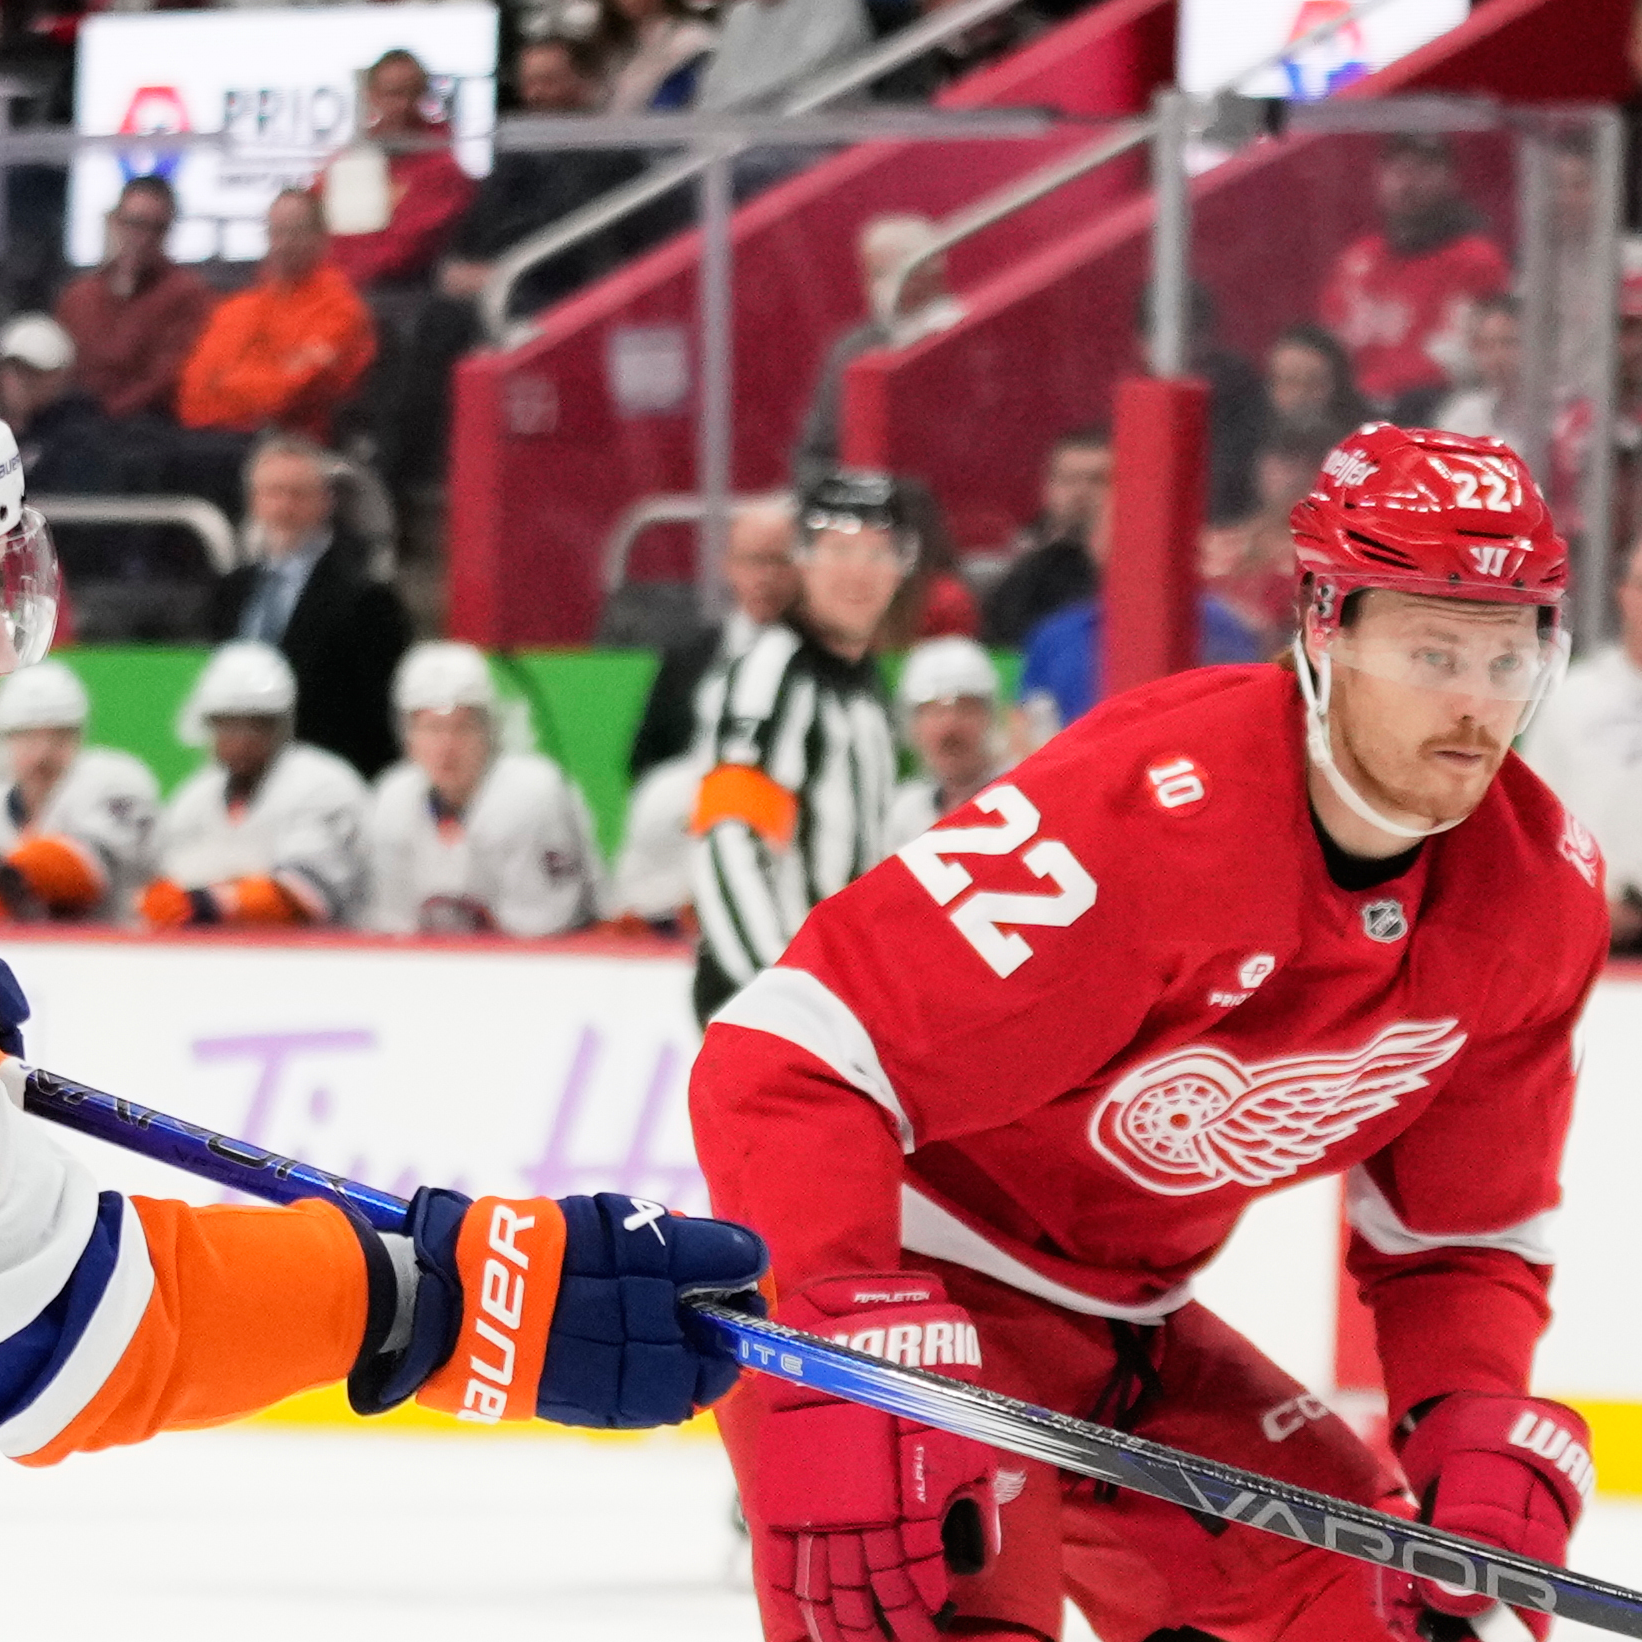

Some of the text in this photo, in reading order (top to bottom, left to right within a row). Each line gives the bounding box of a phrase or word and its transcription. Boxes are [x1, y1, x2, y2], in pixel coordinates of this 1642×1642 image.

[1456, 472, 1511, 513] 22
[899, 784, 1097, 979] 22
[854, 1291, 930, 1303] APPLETON
